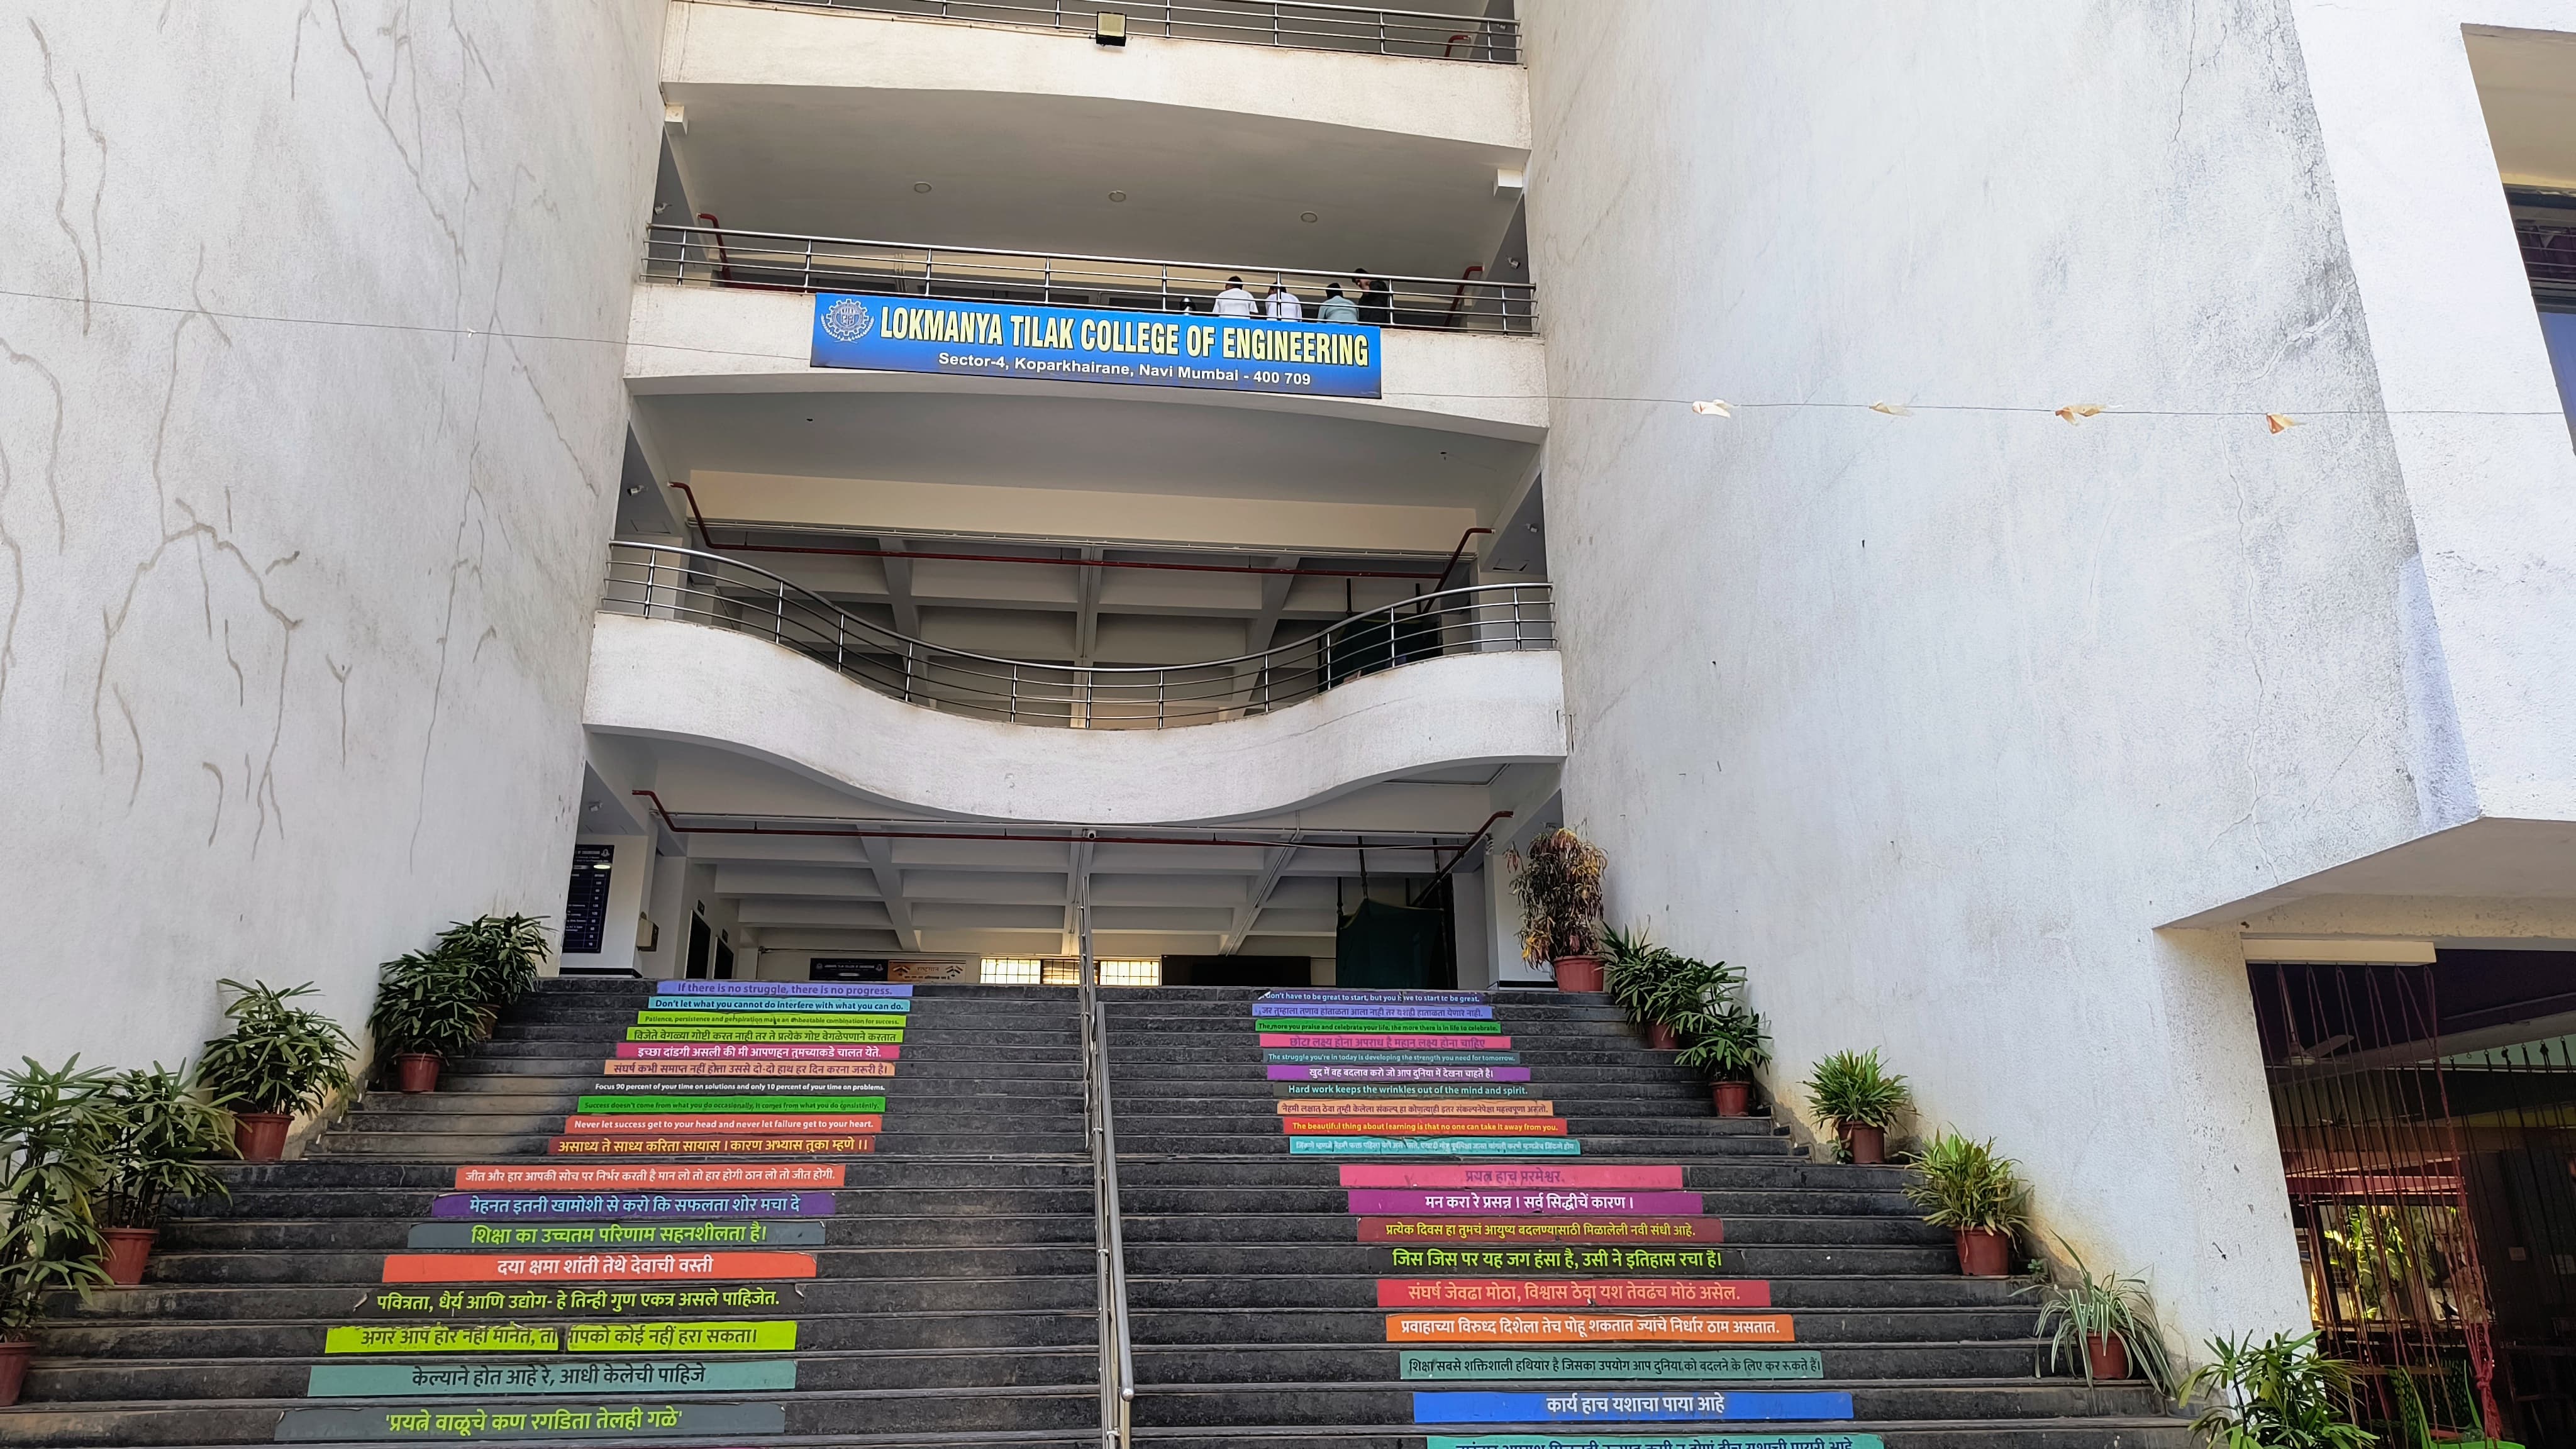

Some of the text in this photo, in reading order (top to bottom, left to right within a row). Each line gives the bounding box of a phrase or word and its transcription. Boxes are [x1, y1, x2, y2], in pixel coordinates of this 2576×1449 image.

[880, 306, 1368, 367] LOKMANYA TILAK COLLEGE OF ENGINEERING
[938, 352, 1009, 370] Sector-4,
[1014, 357, 1133, 377] Koparkhairane,
[1138, 364, 1174, 377] Navi
[1177, 366, 1238, 381] Mumbai
[1253, 370, 1280, 383] 400
[1284, 372, 1310, 385] 709
[678, 983, 686, 992] If
[688, 984, 715, 992] there
[718, 984, 725, 992] is
[743, 985, 789, 995] struggle,
[792, 985, 818, 994] there
[821, 985, 828, 994] is
[846, 987, 892, 996] progress.
[716, 1002, 731, 1010] you
[1289, 1084, 1309, 1093] Hard
[1311, 1084, 1333, 1093] work
[1335, 1085, 1360, 1095] keeps
[1363, 1085, 1377, 1093] the
[1379, 1085, 1415, 1094] wrinkles
[1434, 1085, 1443, 1094] of
[1445, 1085, 1458, 1094] the
[1485, 1085, 1501, 1094] and
[1503, 1084, 1528, 1096] spirit.
[647, 1121, 662, 1130] get
[802, 1121, 816, 1129] get
[470, 1194, 801, 1214] मेहनत इतनी खामोशी से करो कि सफलता शोर मचा दे
[1424, 1196, 1443, 1208] मन
[1445, 1196, 1470, 1208] करा
[1471, 1192, 1480, 1208] रे
[1482, 1196, 1512, 1209] प्रसन्न
[1524, 1192, 1543, 1208] सर्व
[1591, 1196, 1626, 1209] कारण
[471, 1222, 766, 1245] शिक्षा का उच्चतम परिणाम सहनशीलता है।
[497, 1255, 714, 1275] दया क्षमा शांती तेथे देवाची वस्ती
[1392, 1248, 1722, 1269] जिस जिस पर यह जग हंसा है, उसी ने इतिहास रचा है।
[377, 1287, 779, 1313] पवित्रता, धैर्य आणि उद्योग- हे तिन्ही गुण एकत्र असले पाहिजेत.
[1407, 1281, 1441, 1299] संघर्ष
[1444, 1281, 1482, 1300] जेवढा
[1485, 1282, 1521, 1302] मोठा,
[1524, 1281, 1568, 1300] विश्वास
[1571, 1280, 1596, 1299] ठेवा
[1599, 1285, 1623, 1302] यश
[1670, 1282, 1696, 1299] मोठं
[1699, 1282, 1740, 1299] असेल.
[1401, 1319, 1455, 1336] प्रवाहाच्या
[1499, 1318, 1539, 1334] दिशेला
[1541, 1318, 1562, 1333] तेच
[1589, 1318, 1633, 1331] शकतात
[1636, 1318, 1667, 1335] ज्यांचे
[1670, 1318, 1703, 1332] निर्धार
[1706, 1321, 1729, 1333] ठाम
[1733, 1321, 1779, 1333] असतात.
[412, 1362, 706, 1387] केल्याने होत आहे रे, आधी केलेची पाहिजे
[1546, 1394, 1724, 1414] कार्य हाच यशाचा पाया आहे
[436, 1408, 487, 1436] वाळूचे
[492, 1414, 527, 1430] कण
[531, 1408, 592, 1430] रगडिता
[596, 1406, 643, 1430] तेलही
